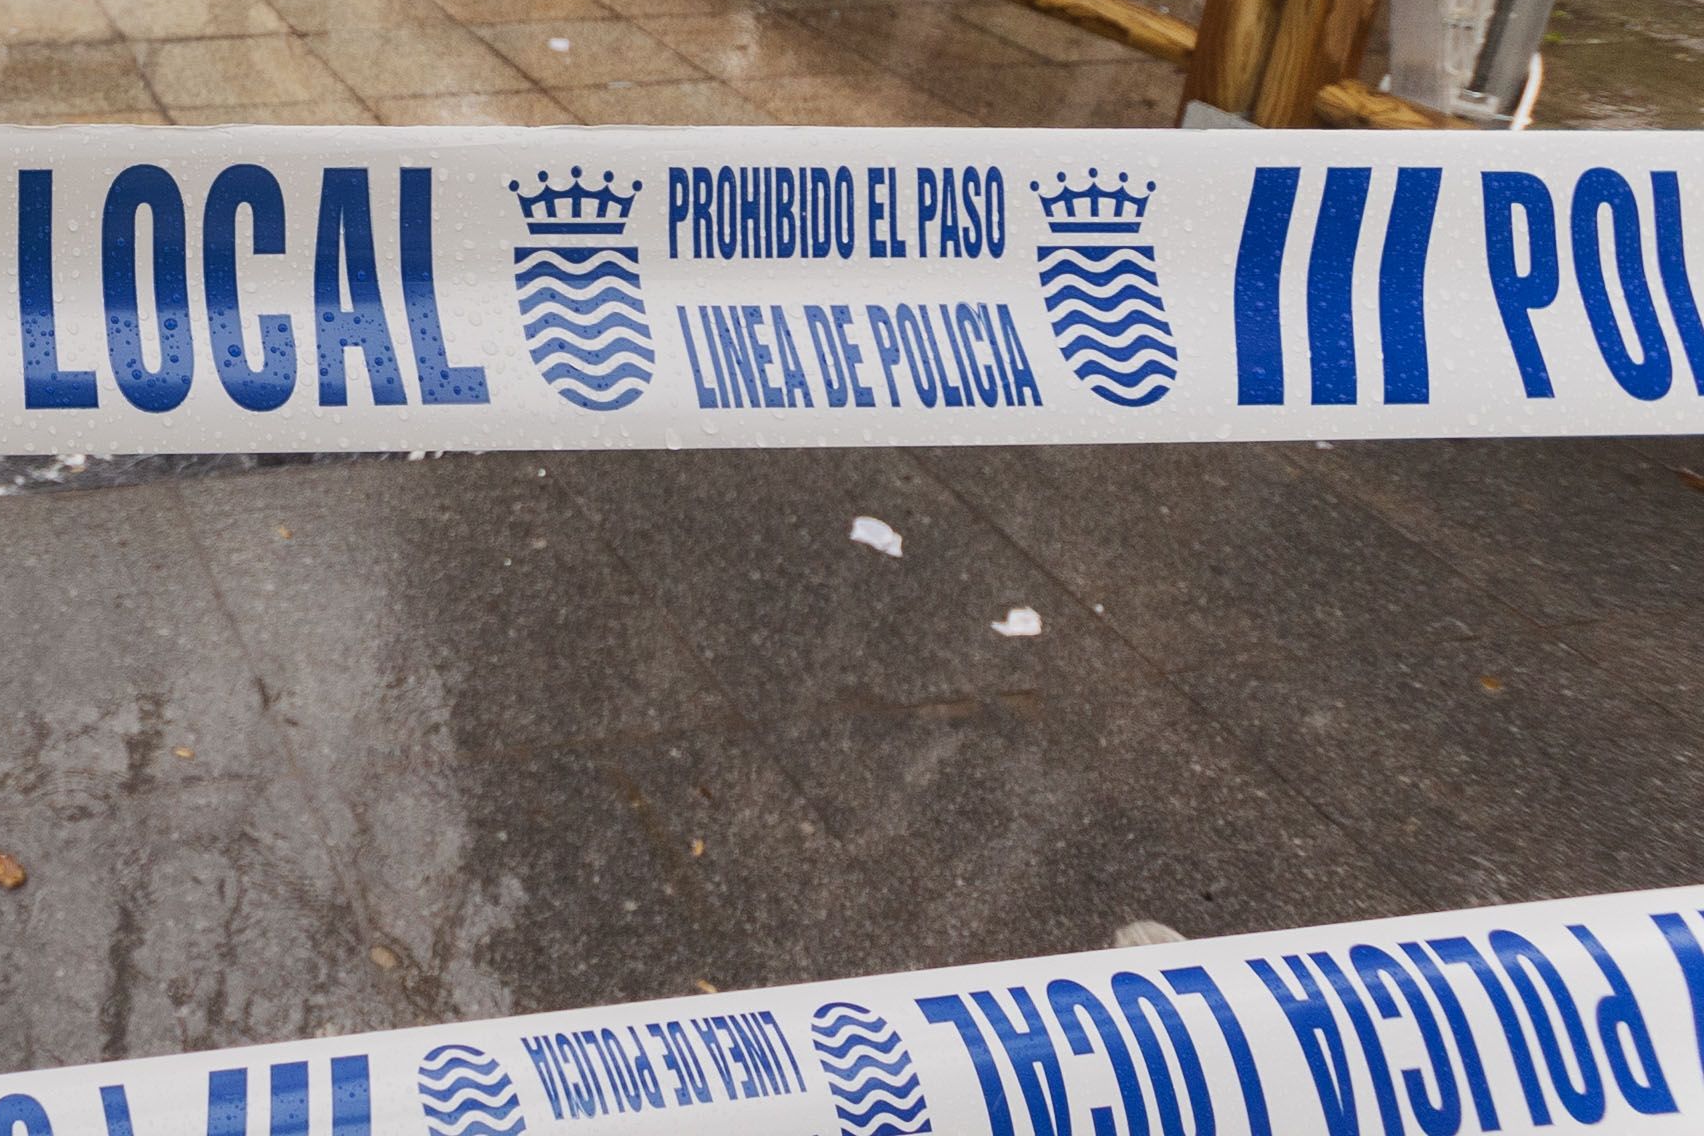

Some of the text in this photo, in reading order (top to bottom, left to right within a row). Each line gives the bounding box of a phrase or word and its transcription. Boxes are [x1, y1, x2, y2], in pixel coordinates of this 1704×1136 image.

[669, 166, 1005, 260] PROHIBIDO EL PASO
[18, 164, 489, 412] LOCAL
[677, 303, 1042, 408] LINEA DE POLICIA
[522, 1011, 805, 1120] LINEA DE POLICIA
[915, 924, 1679, 1136] POLICIA LOCAL
